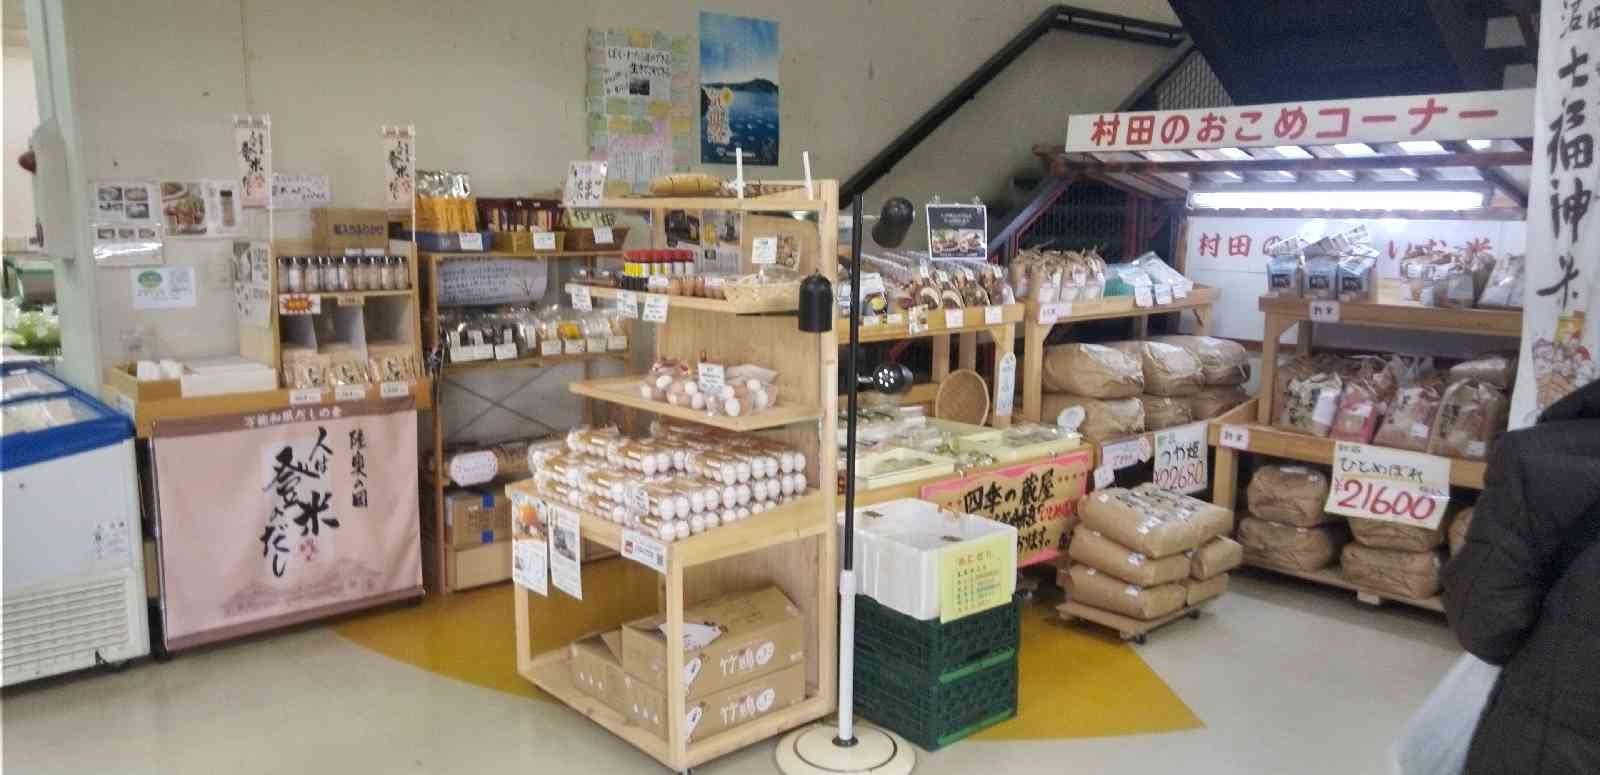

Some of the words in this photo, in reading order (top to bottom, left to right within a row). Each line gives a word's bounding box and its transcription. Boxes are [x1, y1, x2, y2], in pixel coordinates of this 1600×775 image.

[1090, 97, 1499, 146] 村田のおこめコーナー
